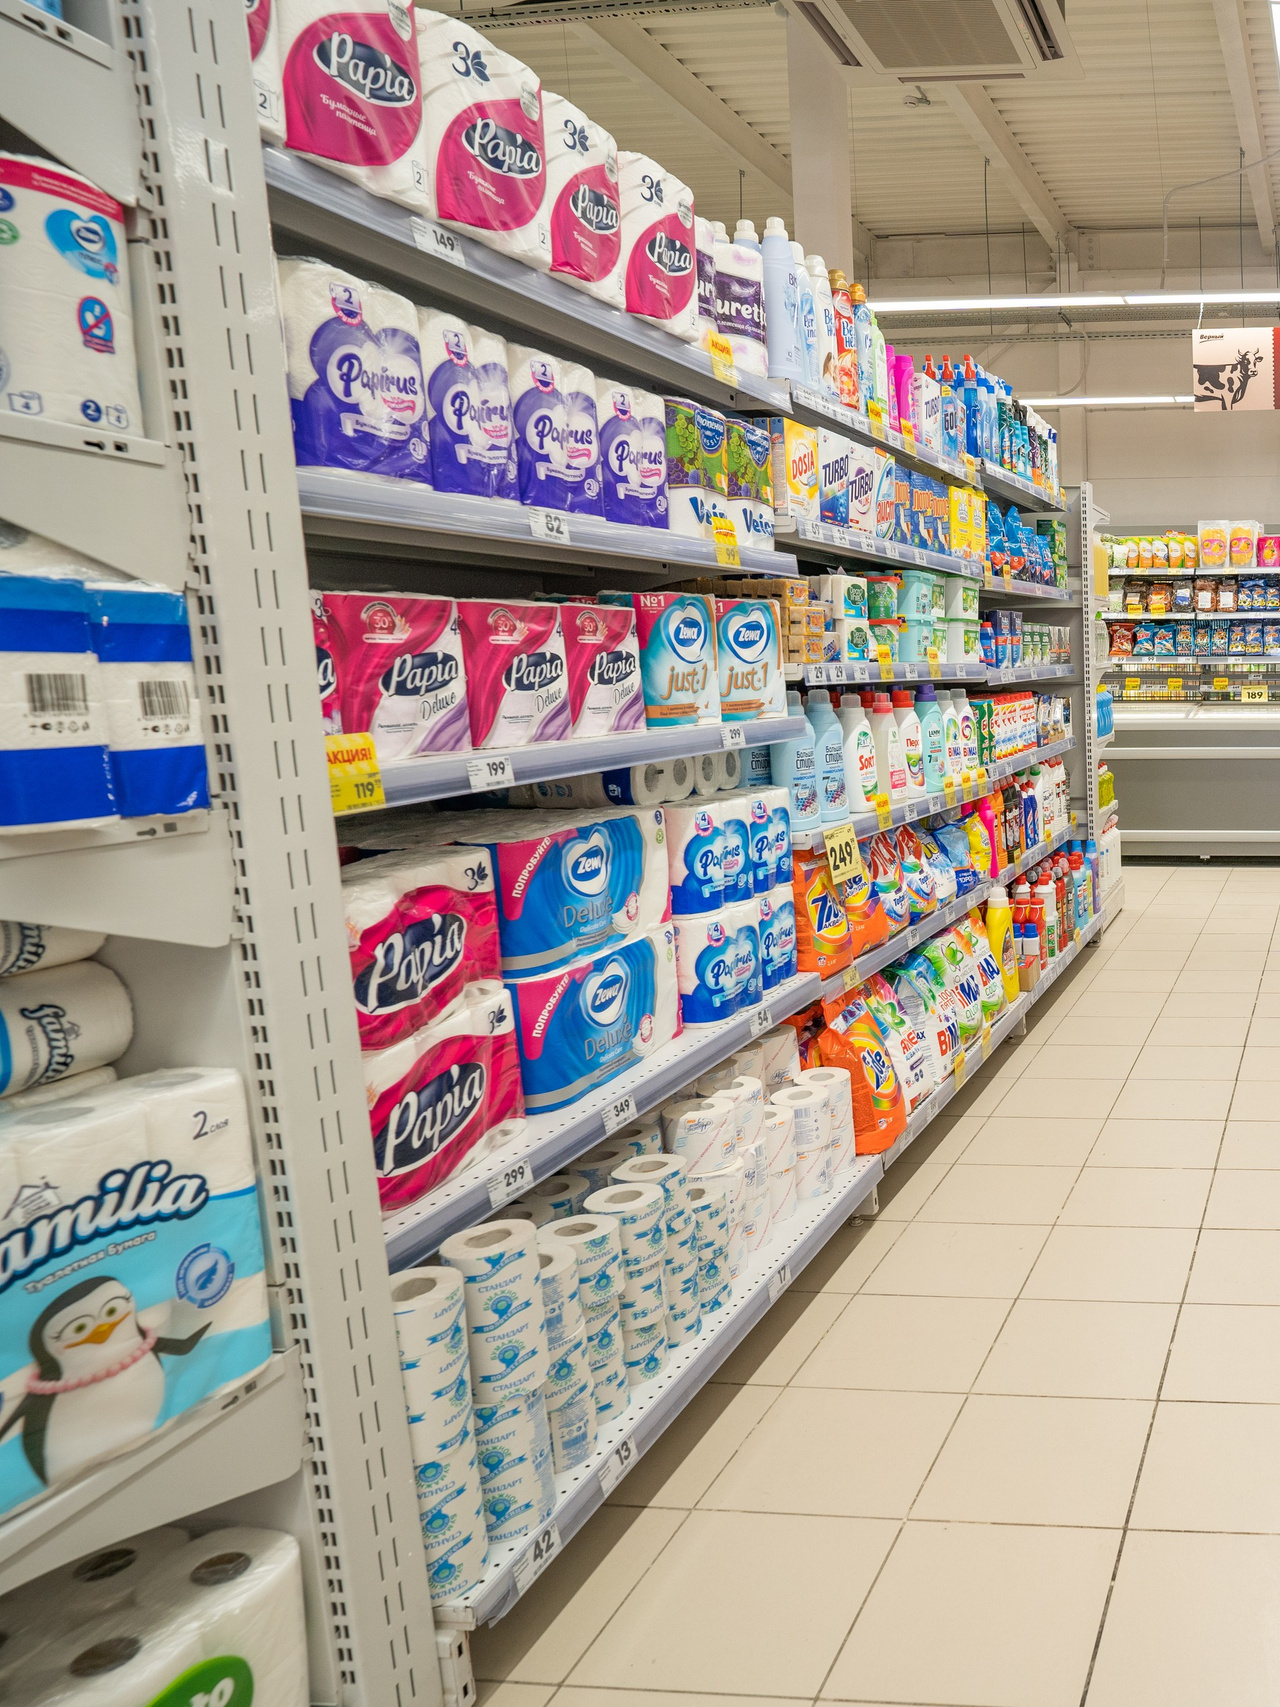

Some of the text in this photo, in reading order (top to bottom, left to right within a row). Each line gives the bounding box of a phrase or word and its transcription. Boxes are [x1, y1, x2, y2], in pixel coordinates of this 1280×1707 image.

[330, 31, 413, 101] Papia
[452, 41, 472, 77] 3
[474, 117, 541, 174] Papia
[563, 119, 577, 150] 3
[416, 171, 423, 186] 2
[640, 175, 654, 202] 3
[577, 184, 618, 232] Papia
[432, 229, 456, 251] 149
[652, 232, 693, 272] Papia
[343, 288, 354, 305] 2
[453, 333, 461, 348] 2
[337, 352, 418, 400] Papirus
[541, 364, 547, 377] 2
[619, 394, 626, 405] 2
[534, 414, 593, 450] Papirus
[615, 440, 663, 477] Papirus
[792, 450, 815, 482] DOSIA
[822, 454, 849, 488] TURBO
[849, 470, 874, 502] TURBO
[545, 514, 564, 535] 82
[640, 595, 666, 607] №1
[678, 623, 699, 640] Zewa
[738, 627, 762, 642] Zewa
[388, 650, 459, 697] Papia
[511, 651, 563, 692] Papia
[593, 649, 636, 686] Papia
[420, 691, 456, 721] Deluxe
[534, 687, 563, 713] Deluxe
[613, 683, 635, 706] Deluxe
[1246, 691, 1264, 700] 189
[729, 728, 741, 739] 299
[326, 747, 372, 765] АКЦИЯ!
[487, 761, 506, 778] 199
[354, 781, 374, 800] 119
[700, 813, 708, 824] 4
[756, 801, 764, 812] 4
[700, 840, 741, 877] Papirus
[829, 841, 853, 871] 249
[464, 868, 478, 891] 3
[763, 899, 769, 909] 4
[713, 923, 720, 935] 4
[763, 923, 794, 955] Papirus
[367, 913, 462, 1014] Papia
[711, 948, 753, 986] Papirus
[532, 973, 571, 1038] ПОПРОБУЙТЕ!
[594, 980, 621, 1006] Zewa
[757, 1011, 769, 1026] 54
[383, 1064, 485, 1176] Papia
[613, 1099, 630, 1118] 349
[193, 1111, 209, 1141] 2
[504, 1165, 525, 1187] 299
[477, 1273, 524, 1294] СТАНДАРТ
[777, 1269, 787, 1285] 17
[485, 1322, 530, 1343] СТАНДАРТ
[492, 1371, 536, 1393] СТАНДАРТ
[615, 1441, 631, 1466] 13
[533, 1529, 555, 1563] 42
